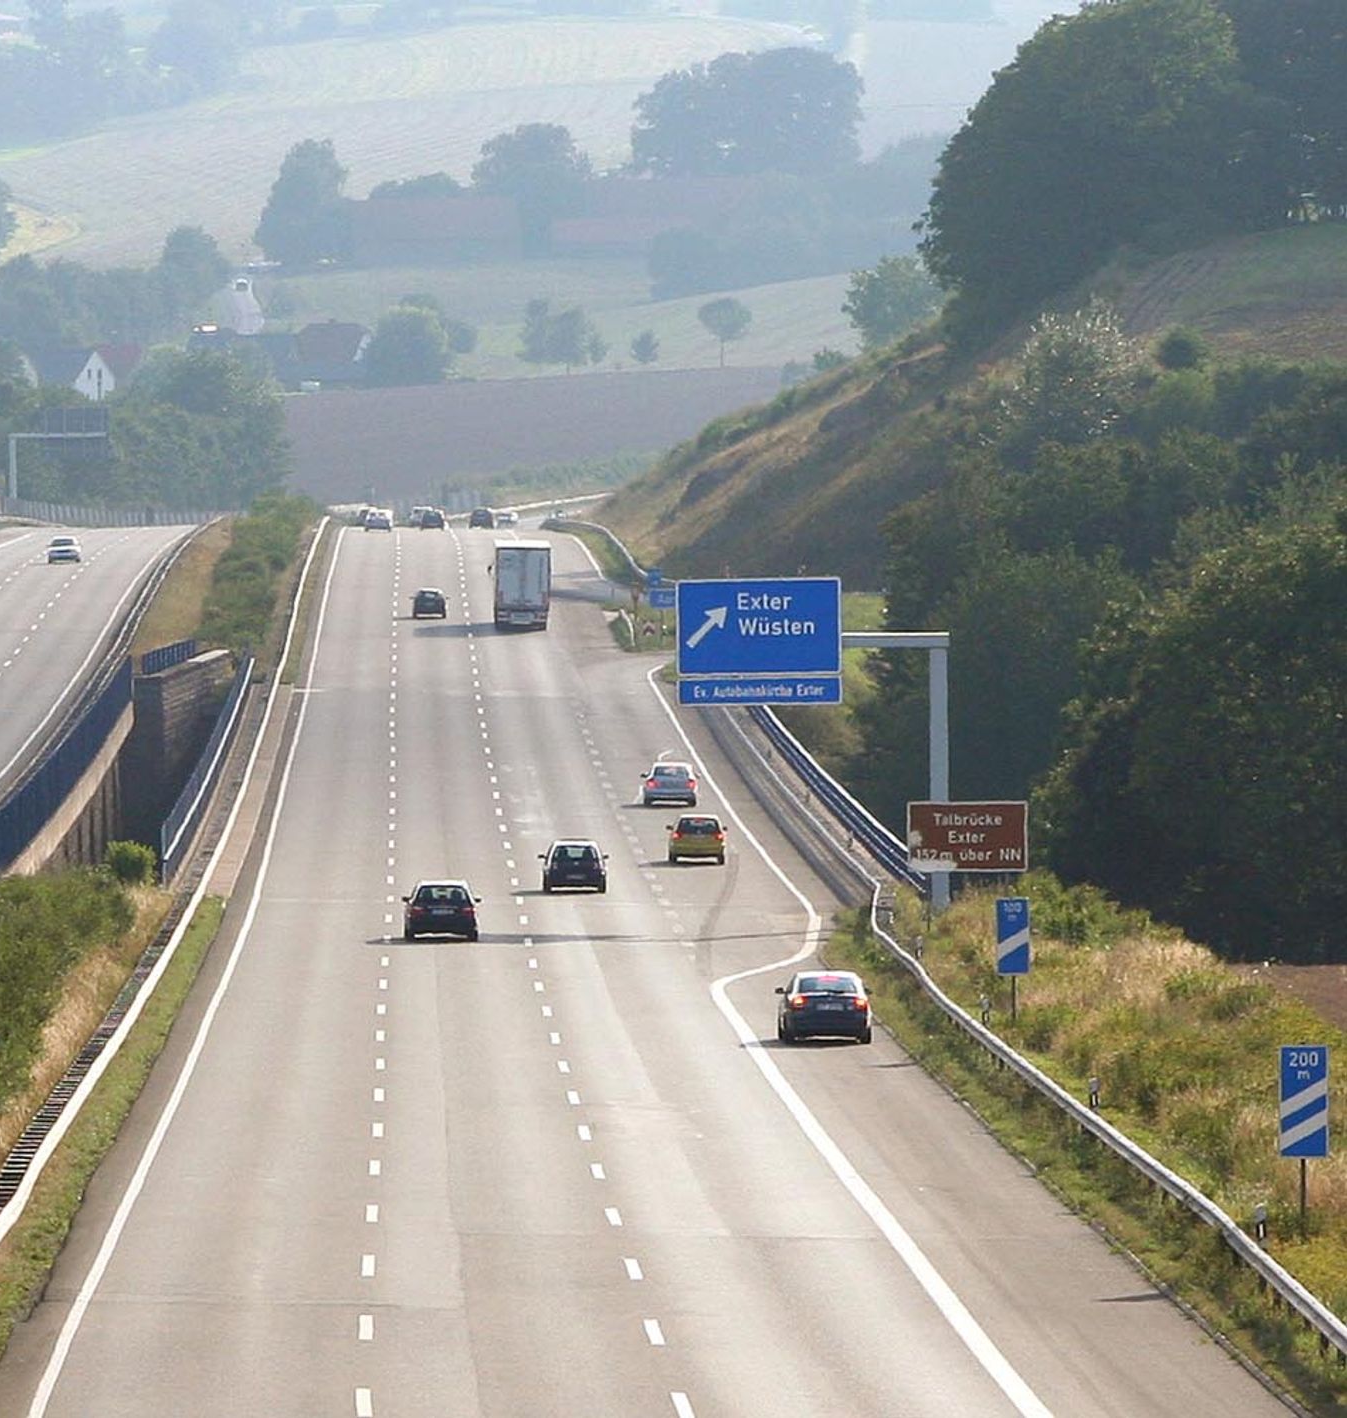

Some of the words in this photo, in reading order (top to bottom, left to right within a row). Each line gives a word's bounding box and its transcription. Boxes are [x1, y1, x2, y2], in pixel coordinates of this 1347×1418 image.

[736, 592, 792, 611] Exter
[738, 617, 815, 636] Wüsten
[693, 685, 709, 698] Ev.
[796, 683, 825, 697] Exter
[933, 812, 1003, 827] Talbrücke
[948, 831, 986, 844] Exter
[959, 848, 992, 862] über
[999, 848, 1022, 861] NN
[1003, 901, 1023, 913] 100
[1289, 1051, 1319, 1067] 200
[1297, 1070, 1310, 1080] m
